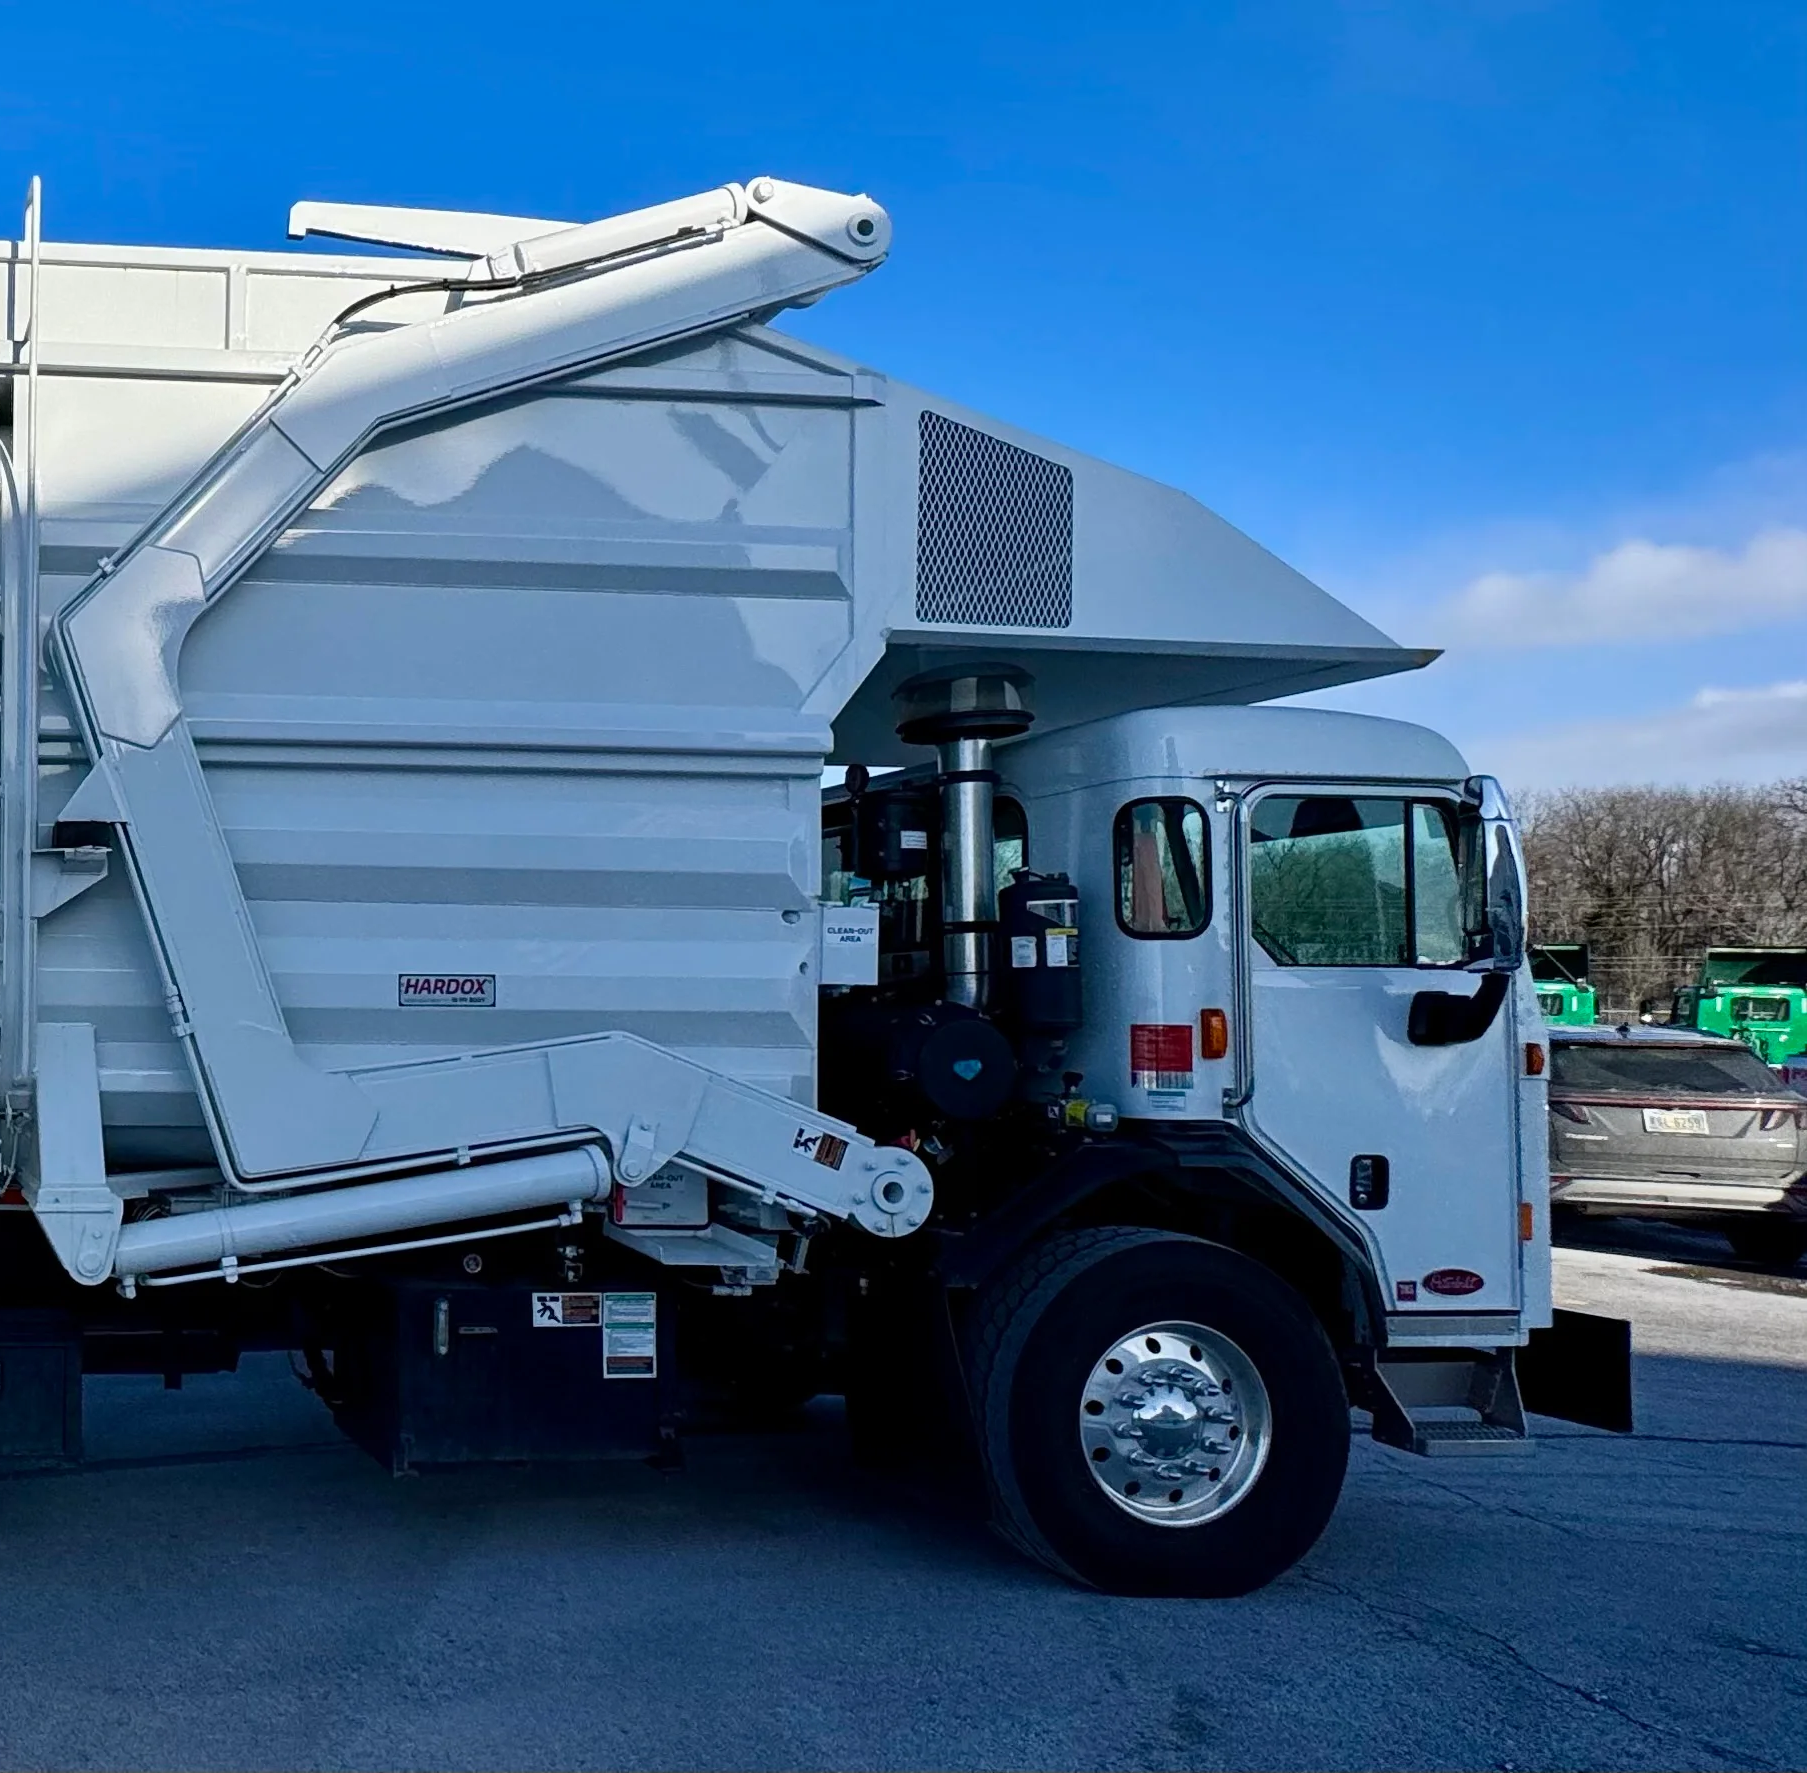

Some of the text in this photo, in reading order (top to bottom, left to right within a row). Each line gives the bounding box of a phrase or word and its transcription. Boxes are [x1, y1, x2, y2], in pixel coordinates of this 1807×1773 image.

[827, 927, 874, 935] CLEAN-OUT
[839, 935, 862, 943] AREA
[403, 978, 488, 995] HARDOX
